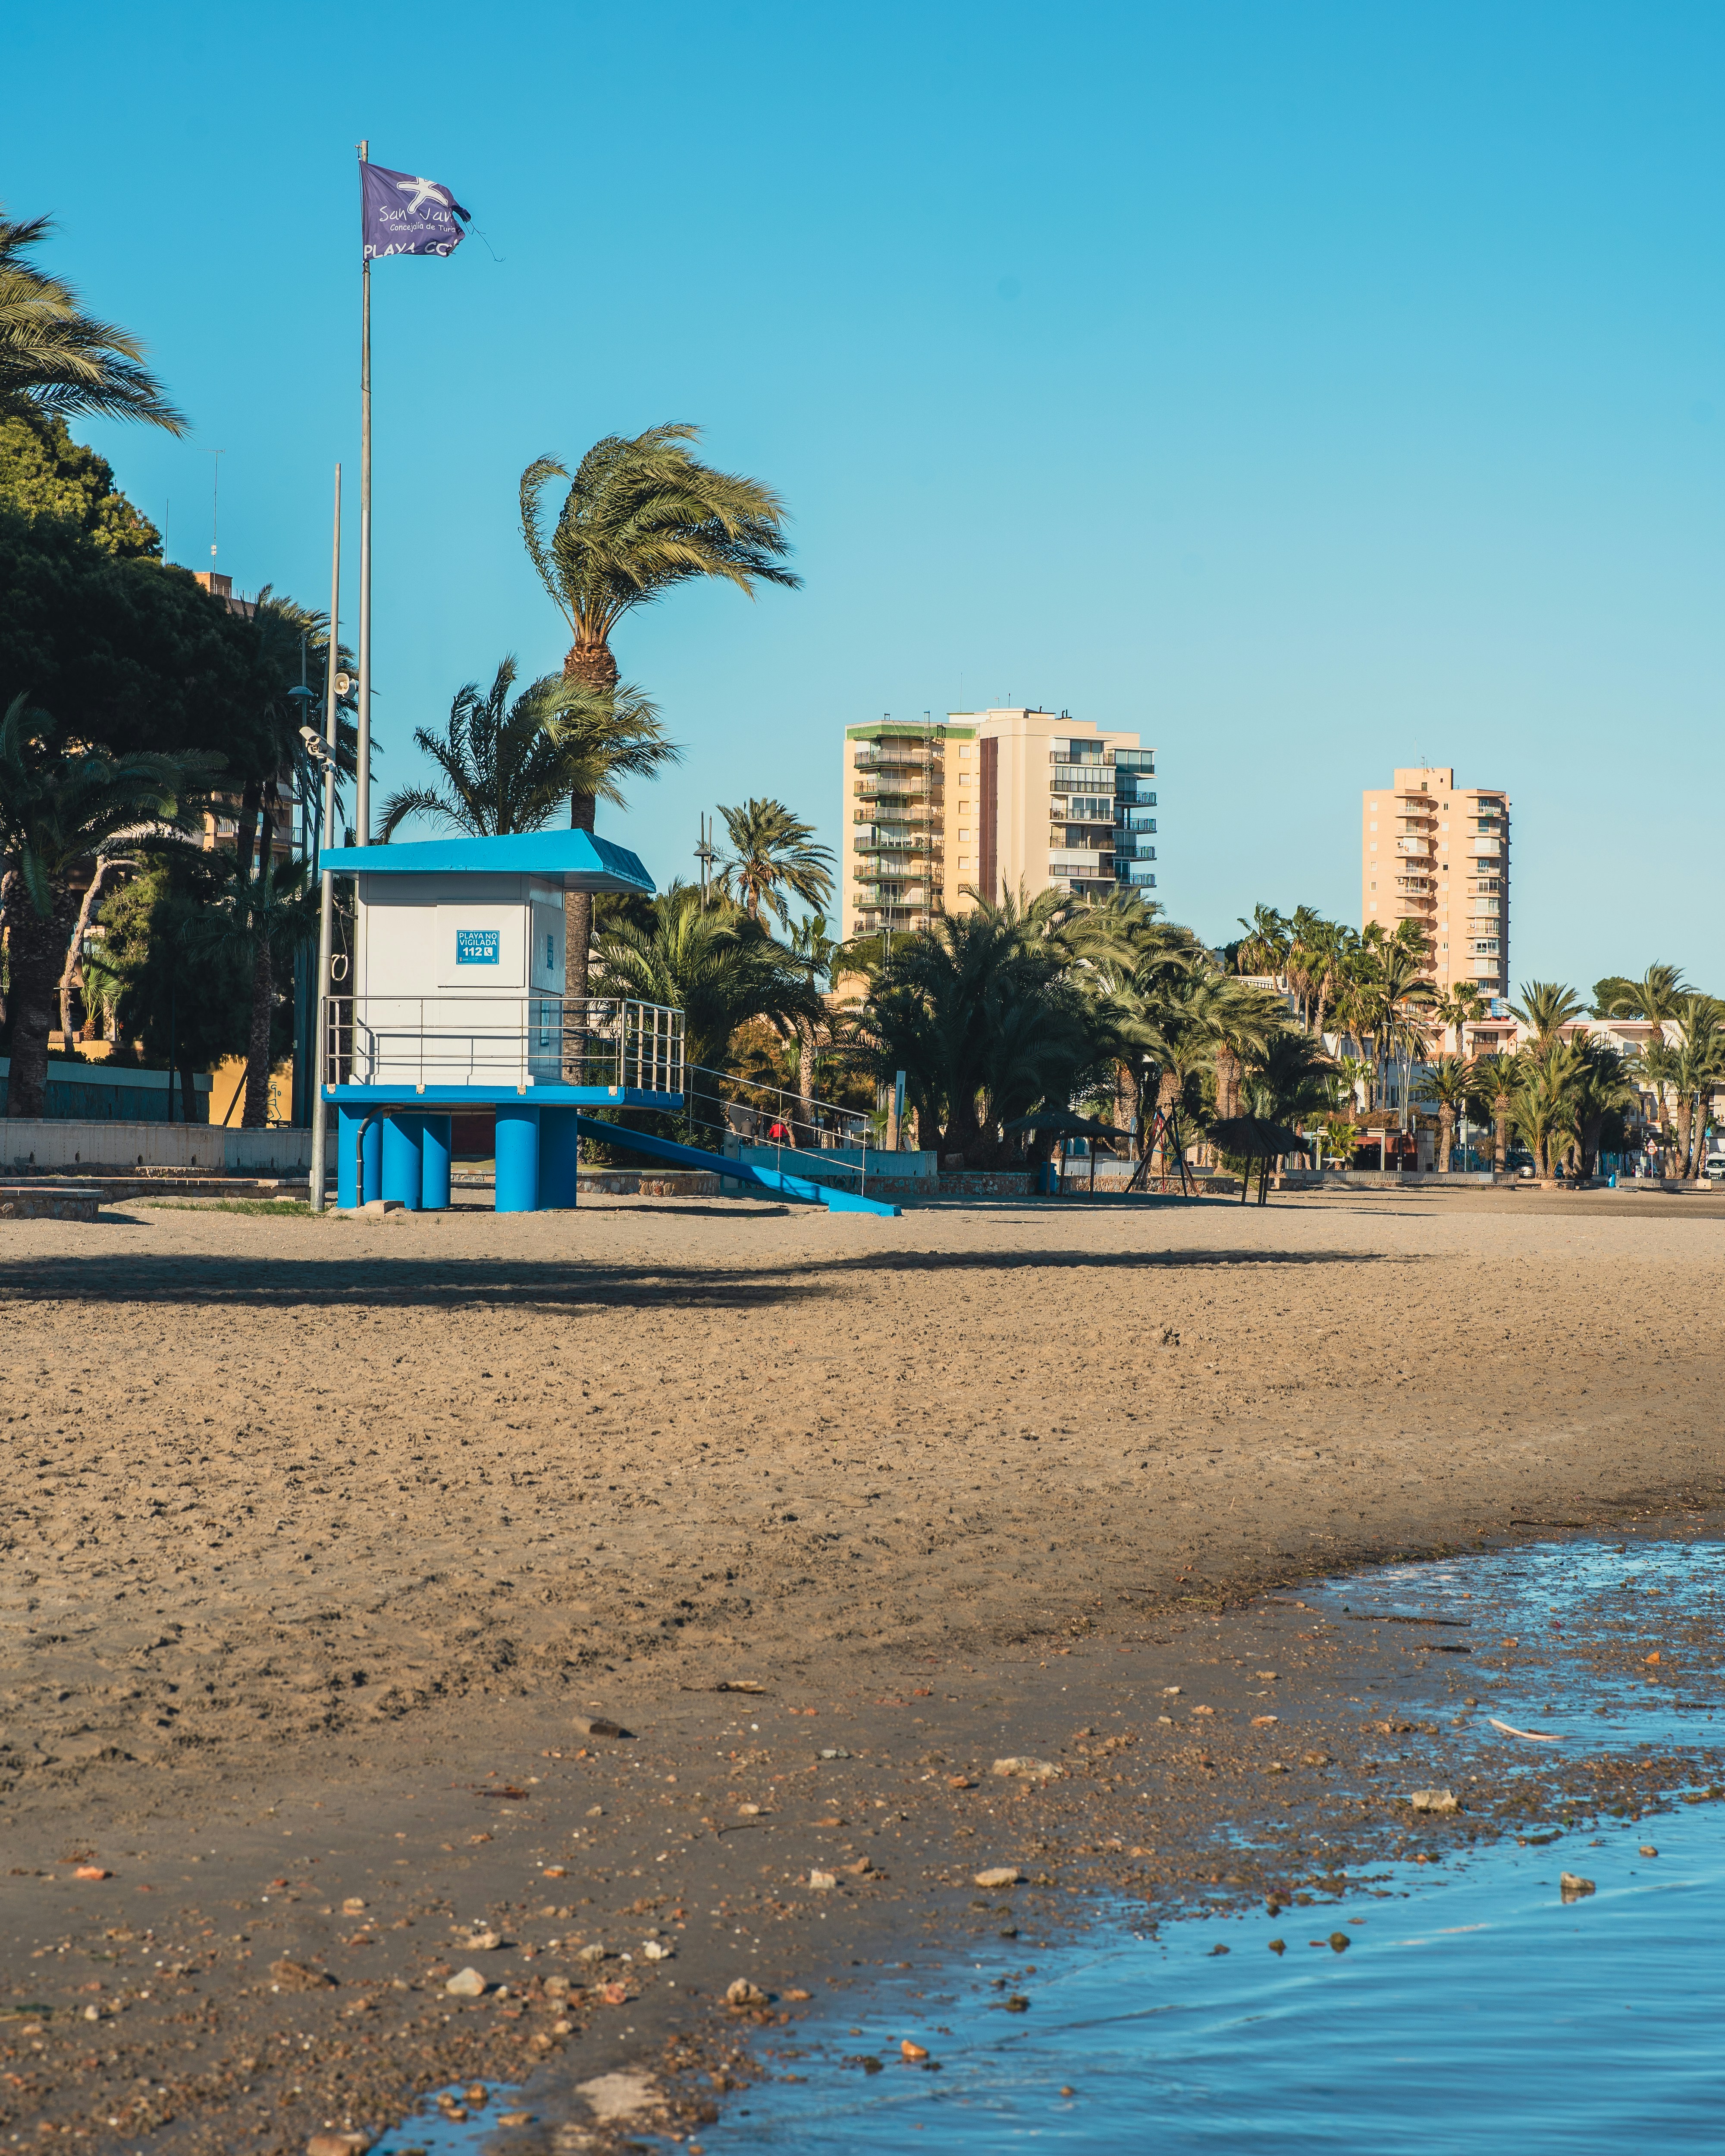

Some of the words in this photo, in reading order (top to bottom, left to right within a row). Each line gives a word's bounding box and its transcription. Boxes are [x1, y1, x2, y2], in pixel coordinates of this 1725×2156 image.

[380, 205, 407, 222] San
[390, 221, 423, 232] Concejalía
[364, 242, 415, 259] PLAYA
[463, 947, 482, 956] 112
